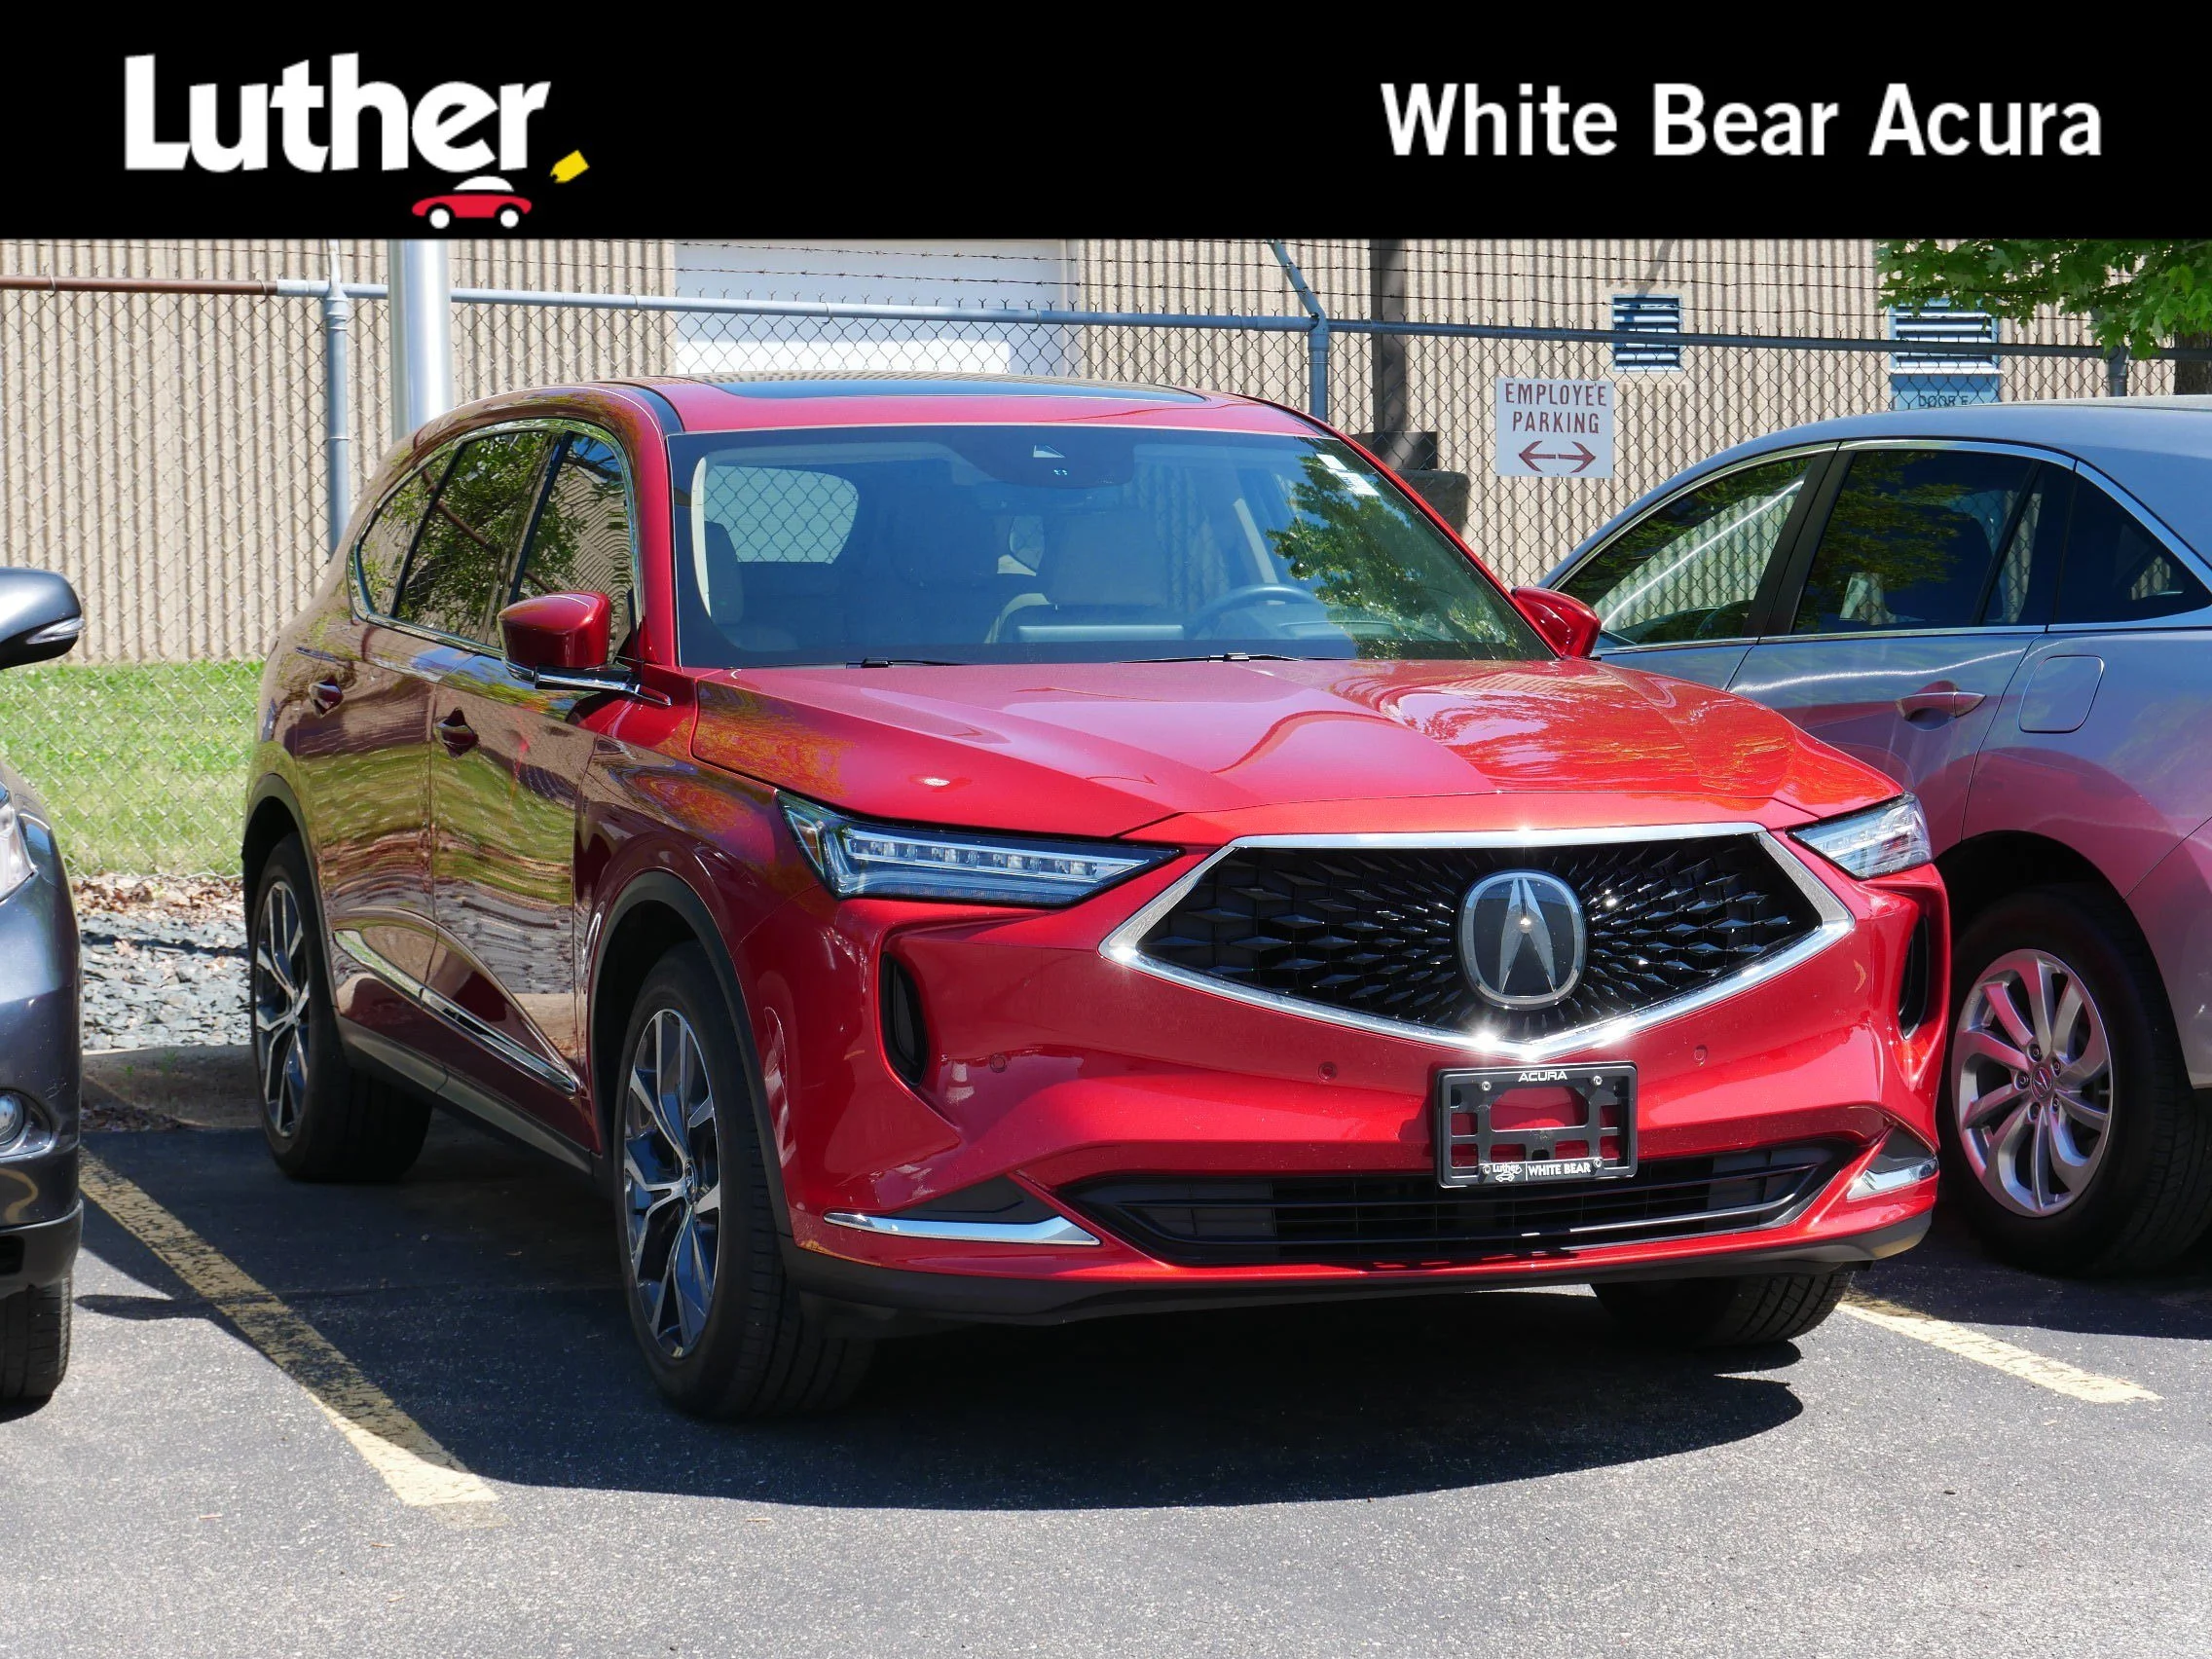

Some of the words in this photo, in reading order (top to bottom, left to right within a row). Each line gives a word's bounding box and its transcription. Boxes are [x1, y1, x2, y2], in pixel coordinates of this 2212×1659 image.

[1505, 383, 1606, 407] EMPLOYEE
[1918, 394, 1956, 407] DOOR
[1513, 411, 1599, 434] PARKING
[1518, 1070, 1567, 1083] ACURA
[1528, 1163, 1562, 1177] WHITE
[1564, 1161, 1591, 1174] BEAR
